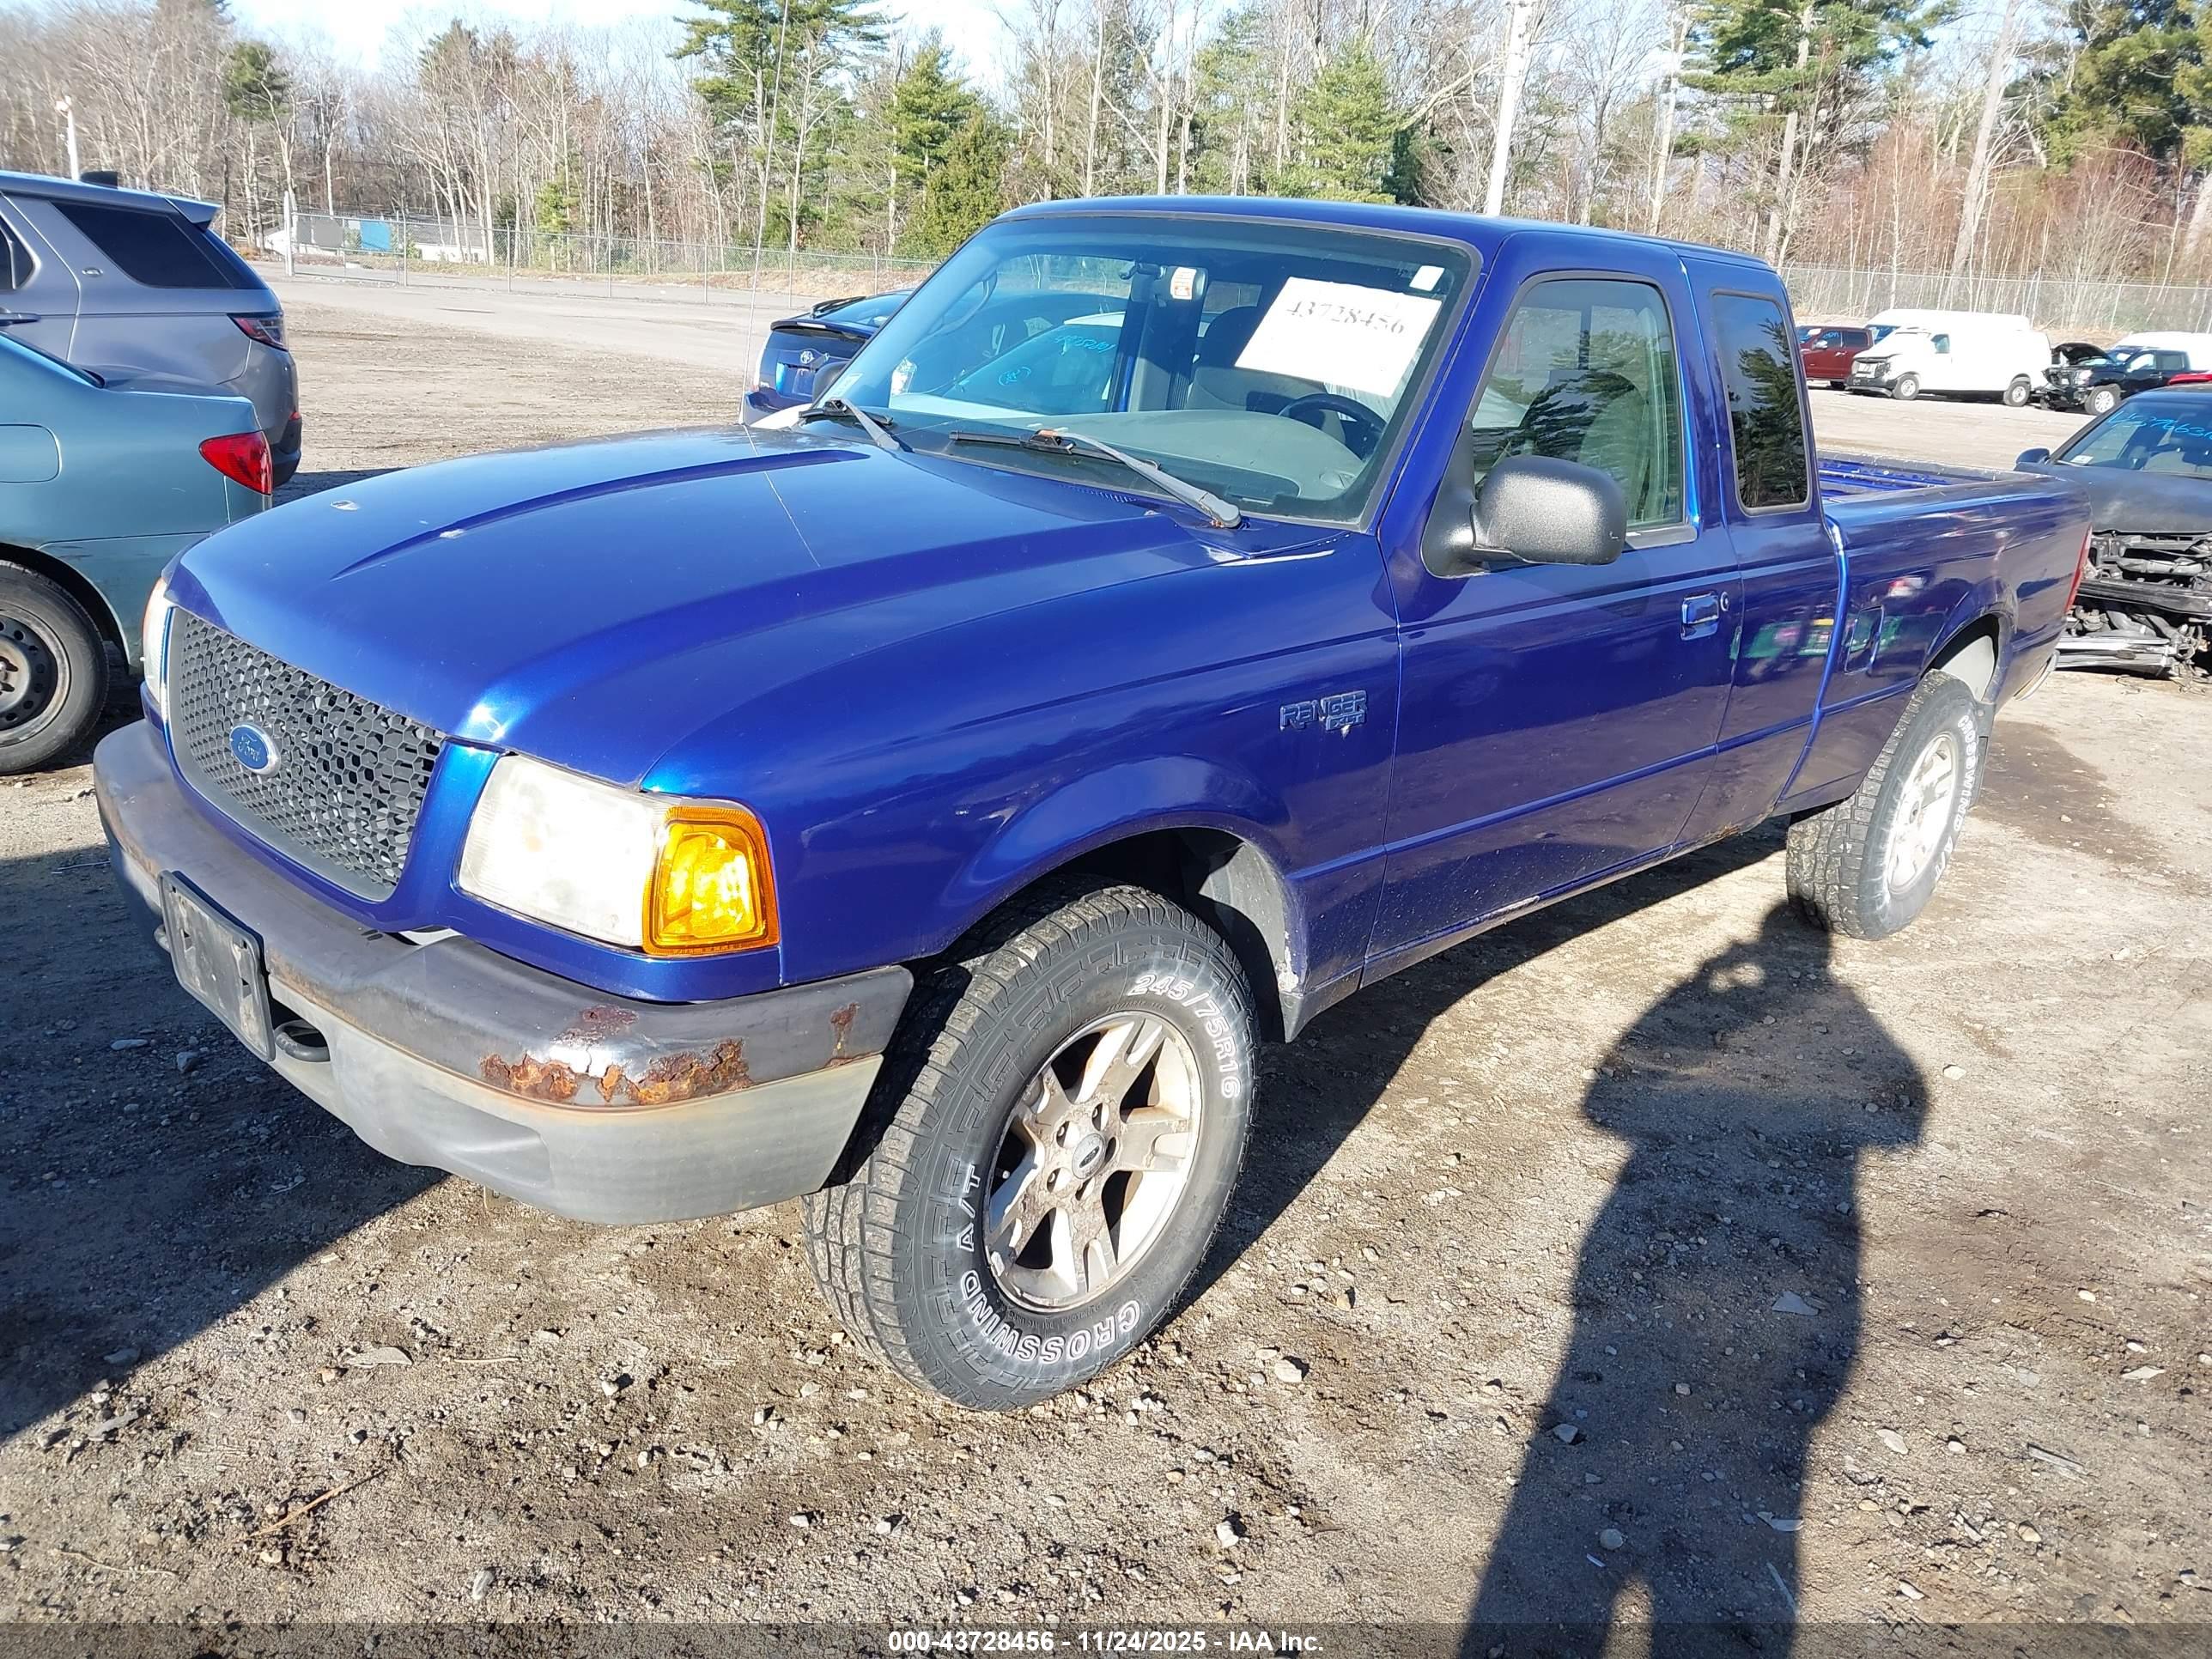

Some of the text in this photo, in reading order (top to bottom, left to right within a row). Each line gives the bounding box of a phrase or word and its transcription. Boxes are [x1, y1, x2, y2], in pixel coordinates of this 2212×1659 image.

[1953, 714, 1978, 832] CROSSWIND
[1126, 973, 1243, 1100] 245/75R16
[957, 1163, 980, 1253] A/T
[957, 1273, 1141, 1364] CROSSWIND
